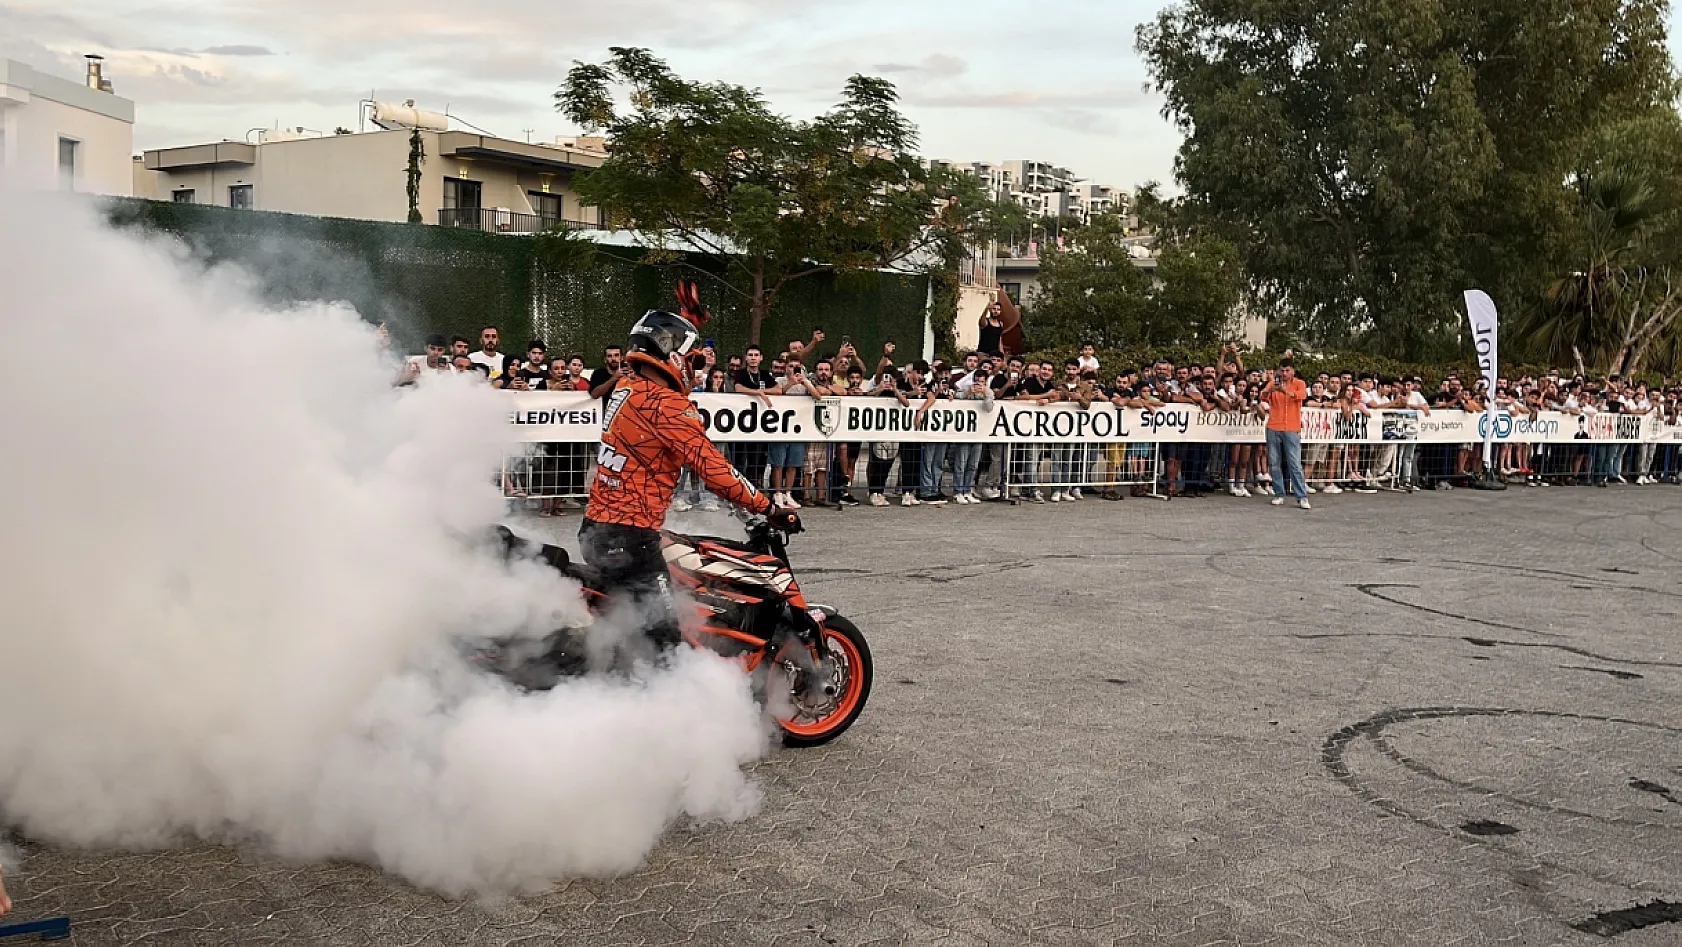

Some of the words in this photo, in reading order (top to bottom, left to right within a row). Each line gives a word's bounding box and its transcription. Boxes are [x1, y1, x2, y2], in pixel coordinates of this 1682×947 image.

[847, 407, 977, 432] BODRUMSPOR
[989, 406, 1129, 437] ACROPOL
[1141, 411, 1189, 433] sipay
